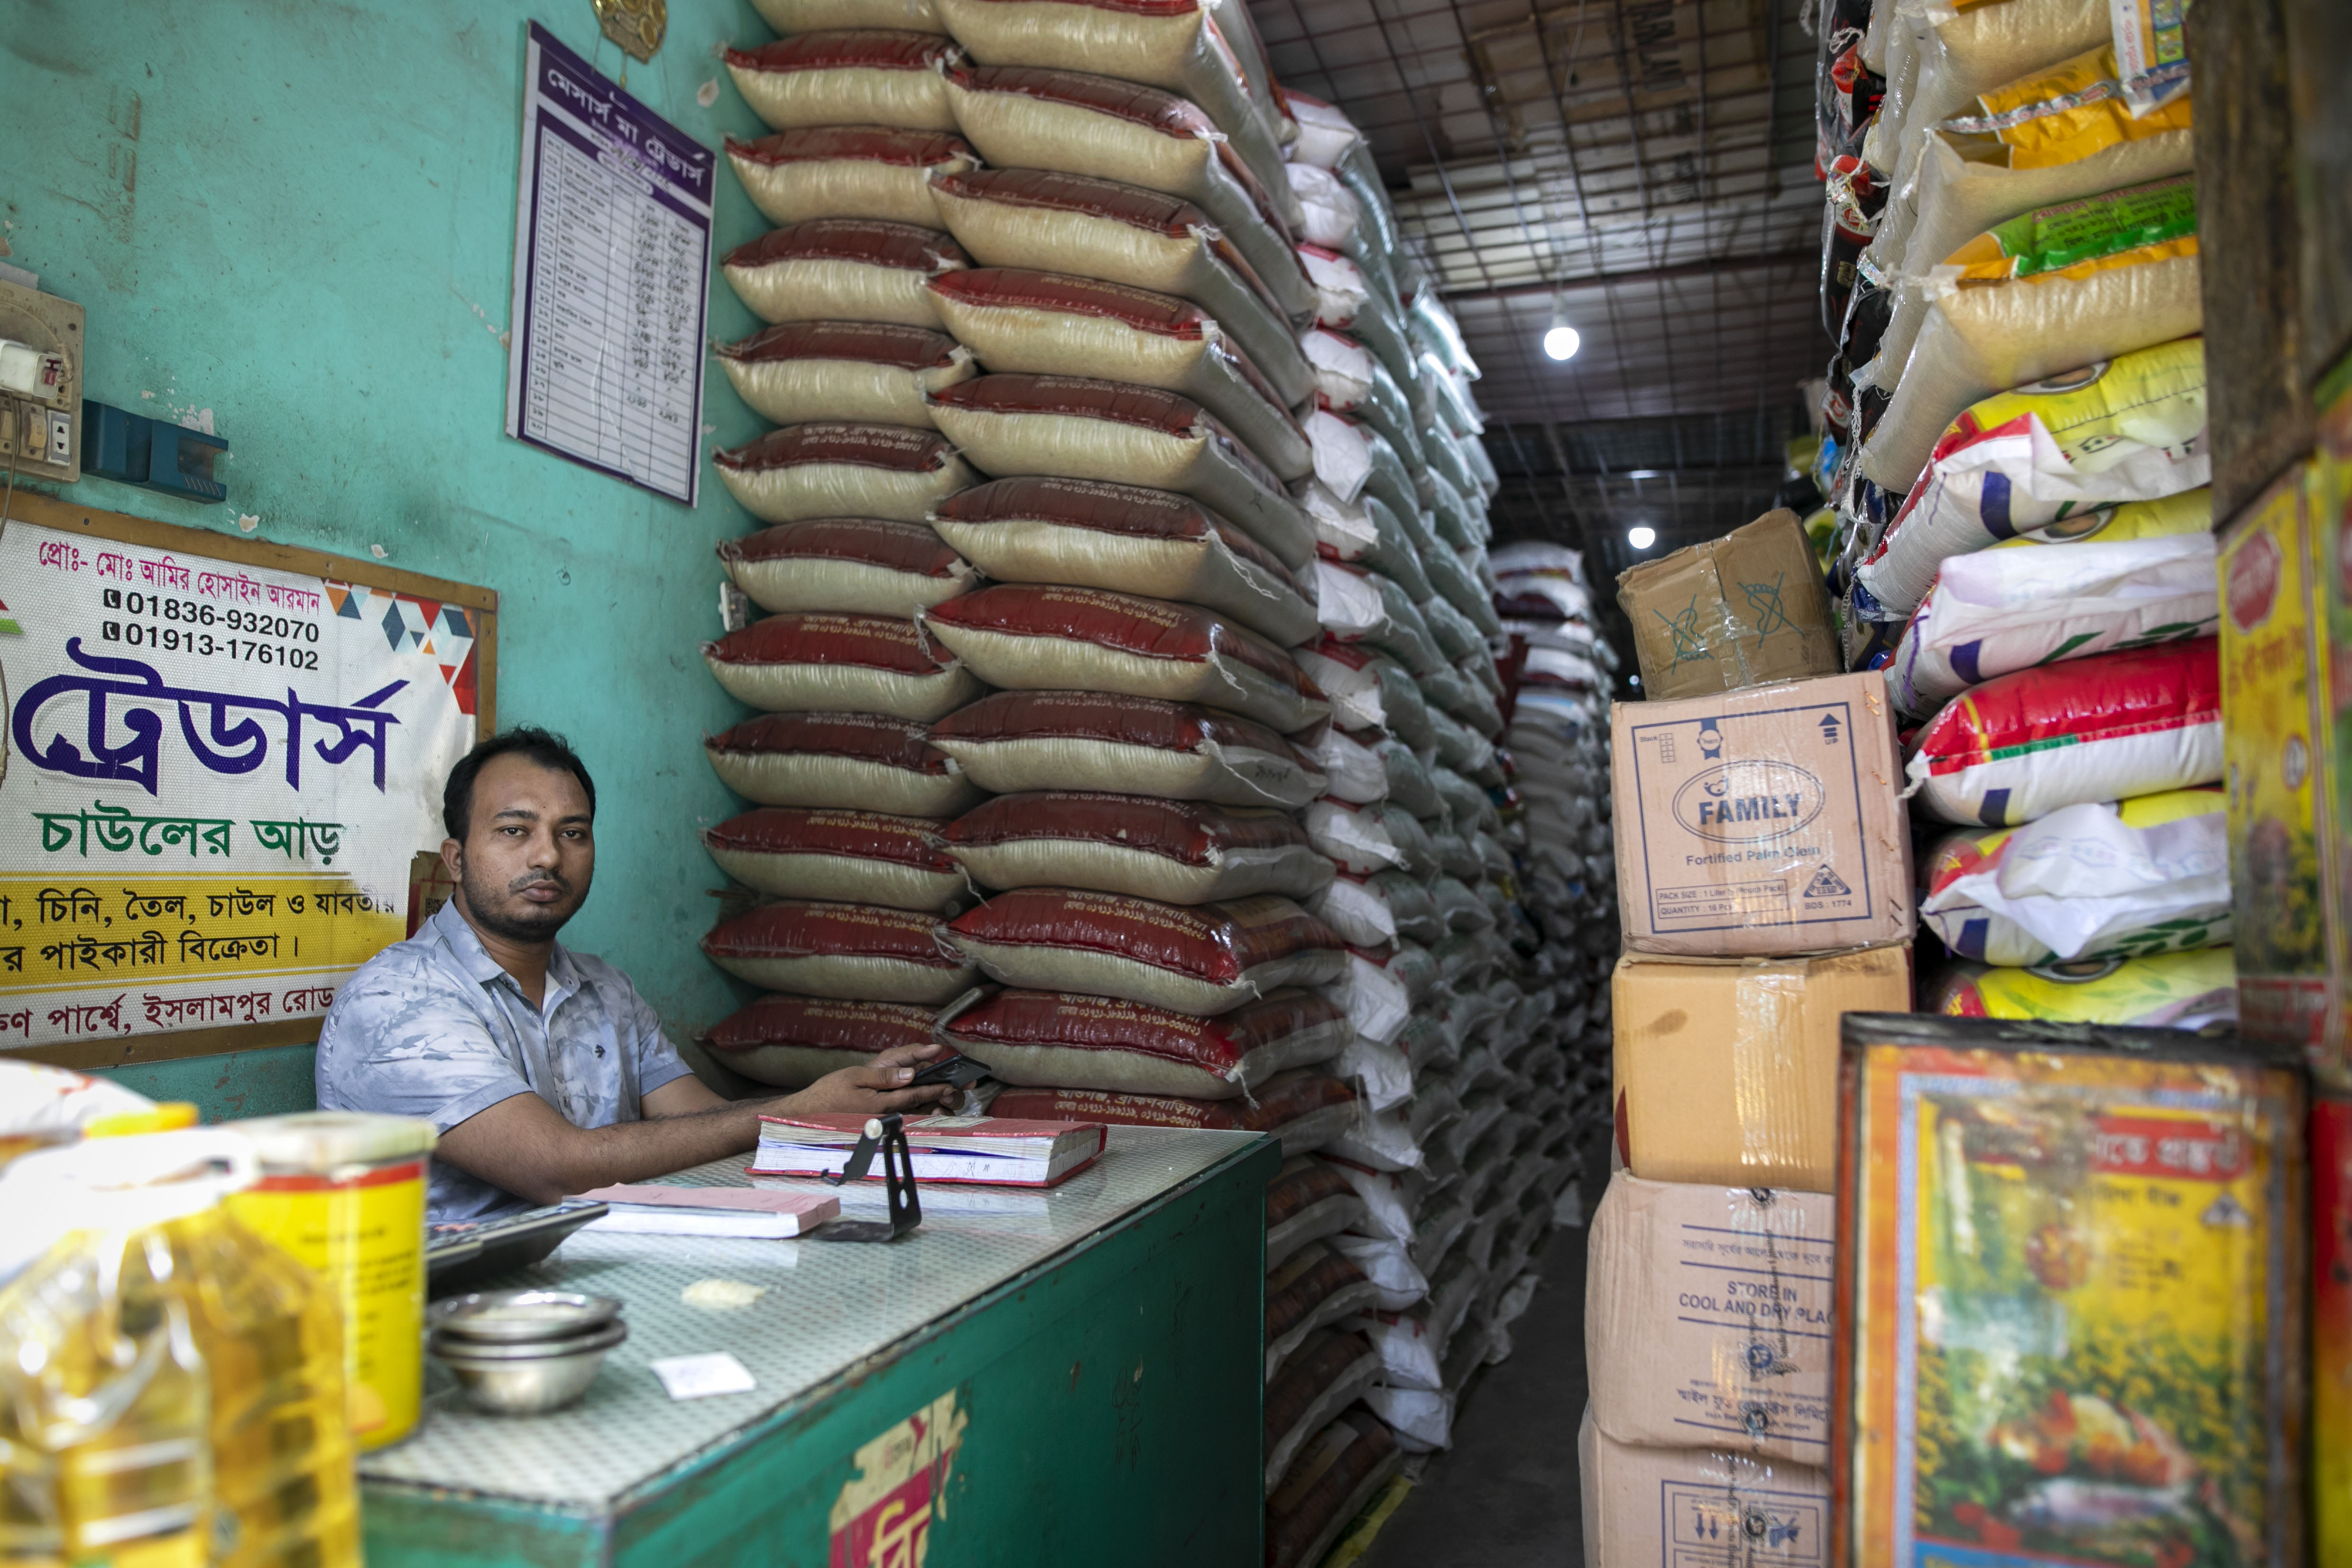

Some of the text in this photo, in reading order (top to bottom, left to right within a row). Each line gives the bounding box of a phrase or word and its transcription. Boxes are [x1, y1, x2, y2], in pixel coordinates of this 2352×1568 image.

[547, 69, 615, 123] মেসার্স
[616, 114, 639, 143] মা
[645, 136, 705, 187] ট্রেডার্স
[97, 552, 133, 582] মোঃ
[140, 556, 190, 590] আমির
[197, 571, 260, 605] হোসাইন
[266, 583, 320, 614] আরমান
[127, 591, 320, 643] 01836-932070
[125, 623, 319, 671] 01913-176102
[12, 636, 410, 797] ট্রেডার্স
[32, 800, 236, 858] চাউলের
[1698, 793, 1802, 825] FAMILY
[1686, 846, 1821, 866] Fortified Palm Olein
[34, 887, 112, 928] চিনি,
[123, 888, 196, 925] তৈল,
[207, 887, 277, 917] চাউল
[286, 895, 305, 914] ও
[1659, 892, 1679, 900] PACK
[1681, 890, 1697, 899] SIZE
[1709, 889, 1725, 897] Liter
[1660, 905, 1700, 915] QUANTITY
[1804, 901, 1824, 910] BDS
[40, 930, 167, 971] পাইকারী
[178, 928, 282, 964] বিক্রেতা
[143, 987, 272, 1028] ইসলামপুর
[283, 985, 335, 1014] রোড
[1682, 1238, 1715, 1251] সরাসরি
[1679, 1293, 1720, 1311] COOL
[1724, 1299, 1756, 1316] AND
[1761, 1302, 1792, 1320] DRY
[1727, 1281, 1798, 1302] STORE IN
